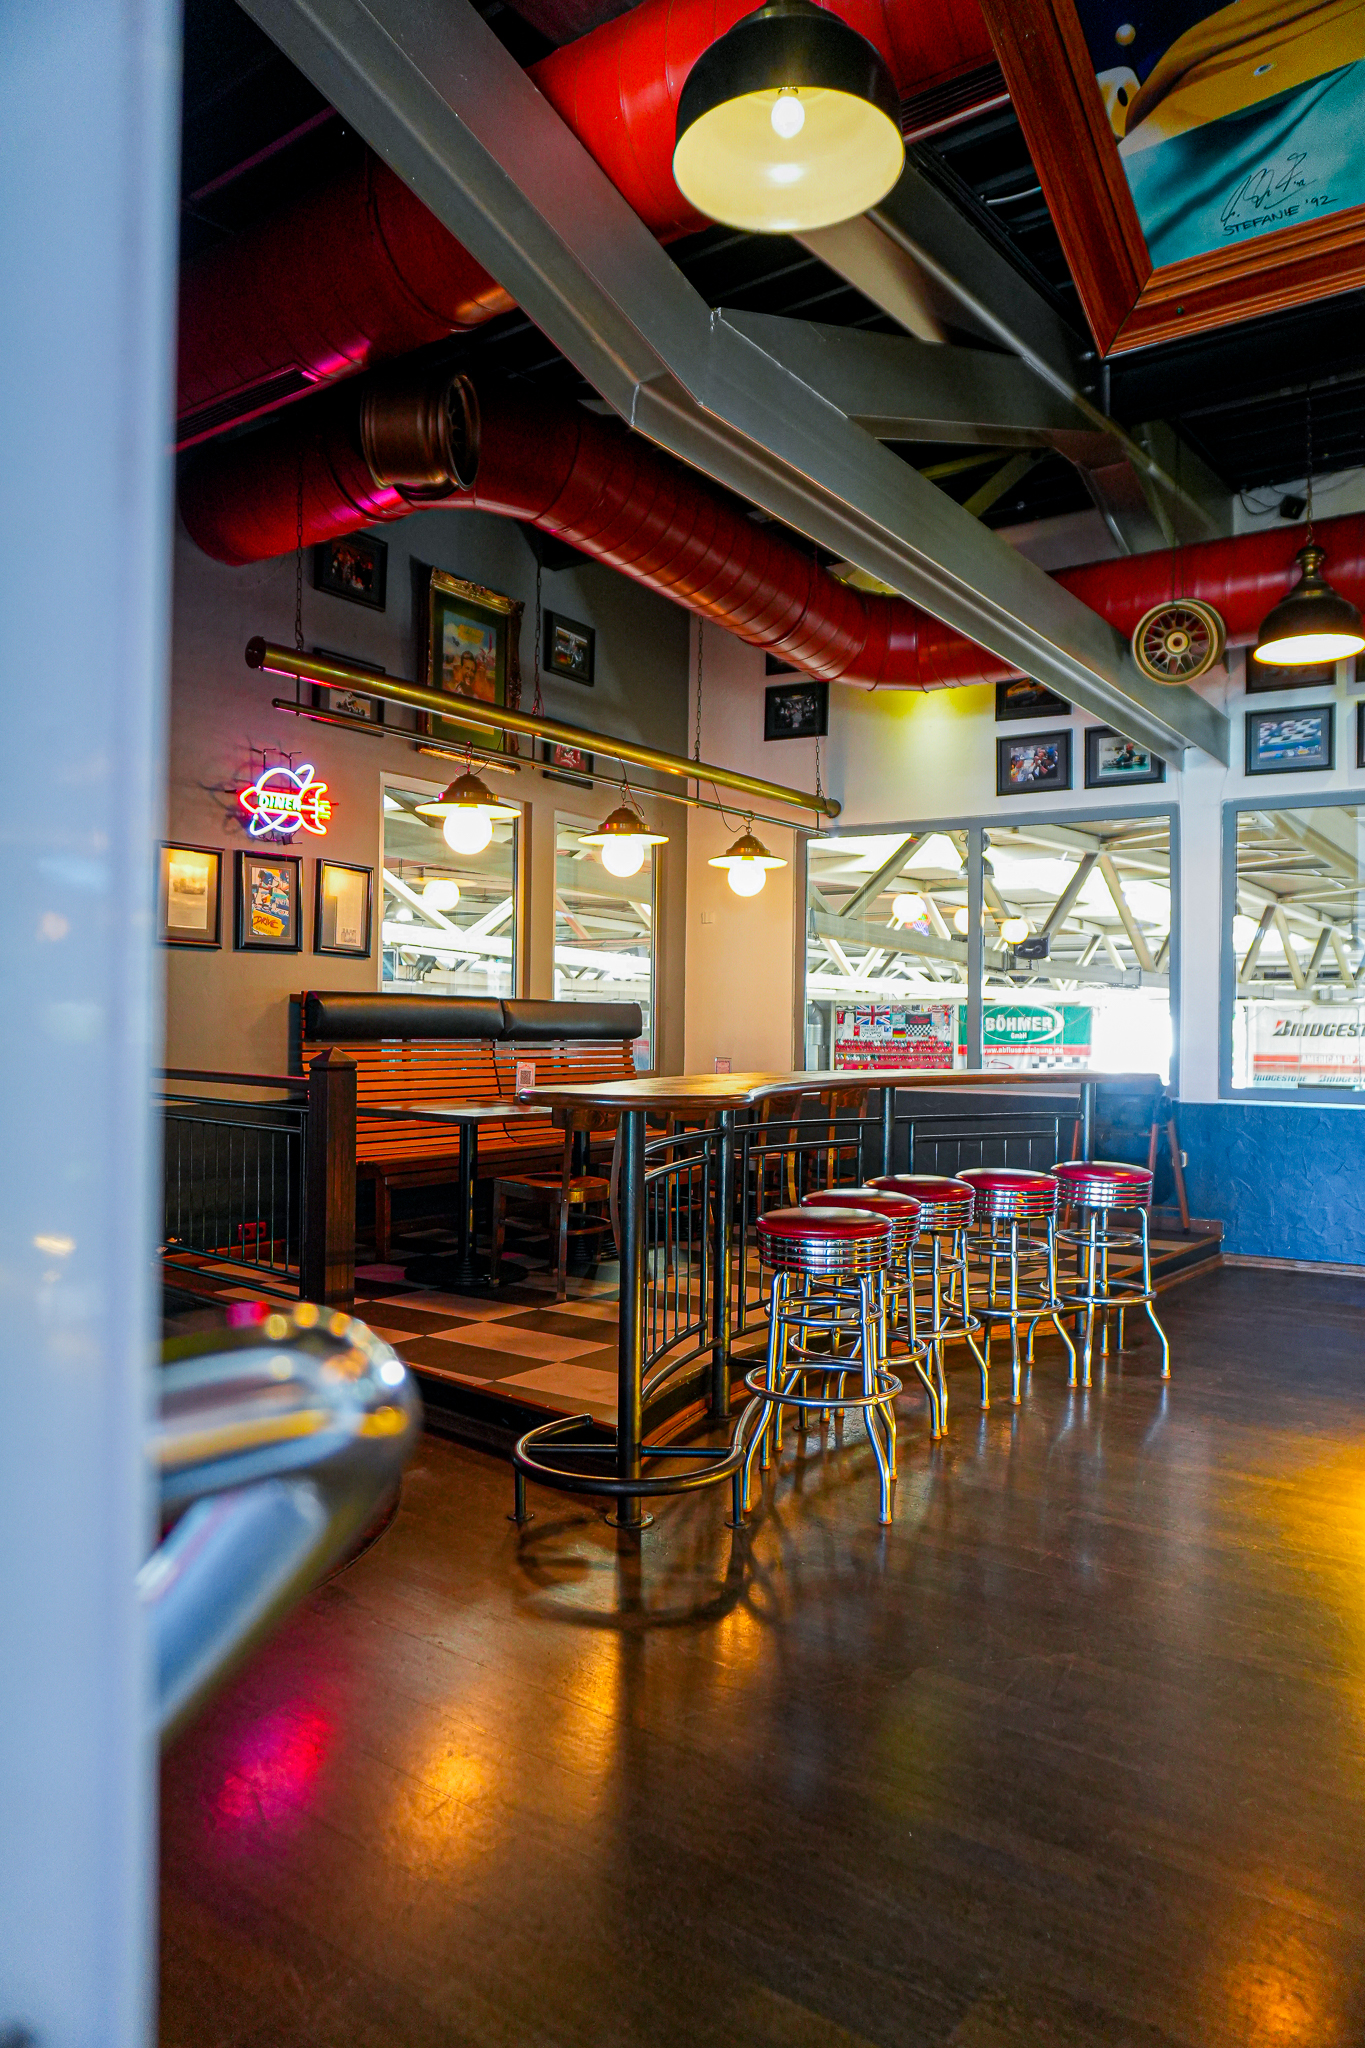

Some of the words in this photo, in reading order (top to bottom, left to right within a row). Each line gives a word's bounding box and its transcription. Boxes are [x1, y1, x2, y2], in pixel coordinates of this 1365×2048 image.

[1222, 205, 1300, 236] STEFANIE
[1305, 195, 1340, 207] '92
[259, 795, 302, 812] DINER
[985, 1014, 1054, 1032] BÖHMER
[1301, 1055, 1342, 1064] AMERICAN
